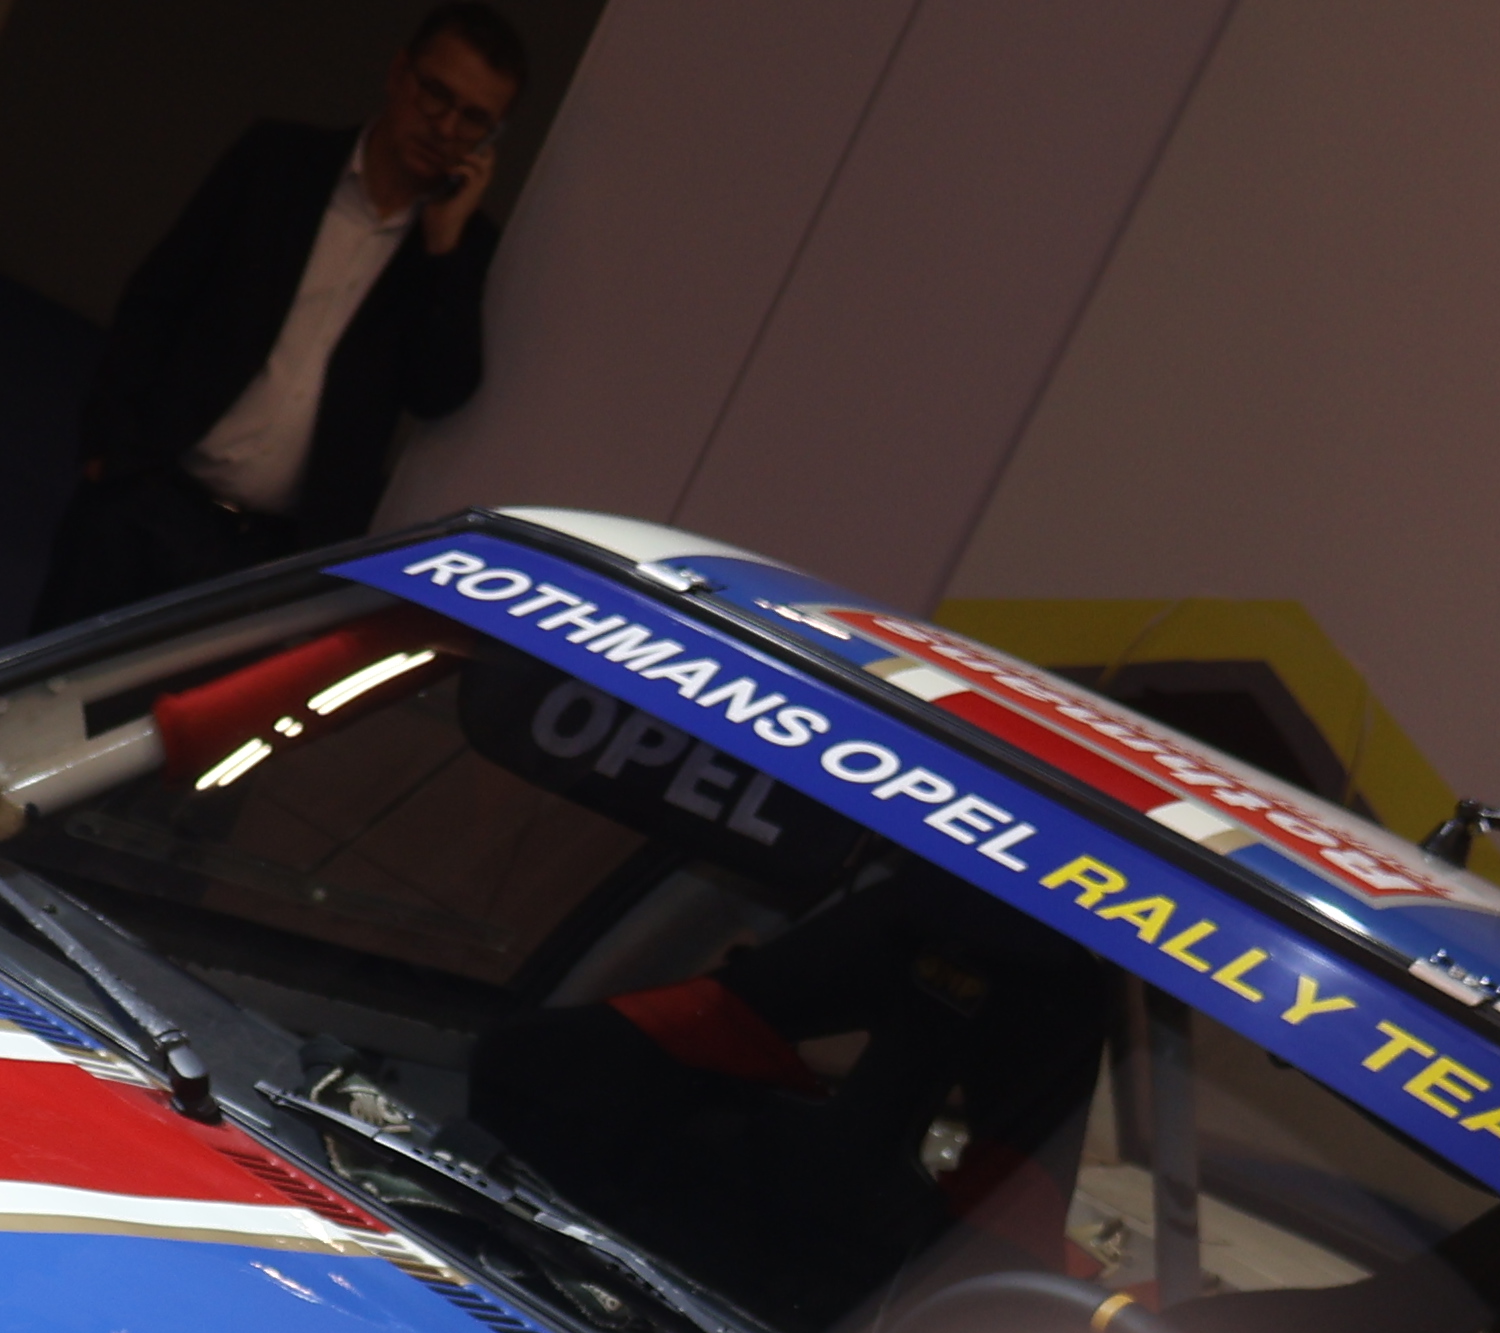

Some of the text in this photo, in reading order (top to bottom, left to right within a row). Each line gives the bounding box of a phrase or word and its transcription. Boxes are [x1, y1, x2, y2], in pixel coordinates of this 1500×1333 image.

[403, 548, 833, 750] ROTHMANS
[819, 741, 1048, 874] OPEL
[1036, 853, 1358, 1028] RALLY
[528, 673, 788, 846] OPEL
